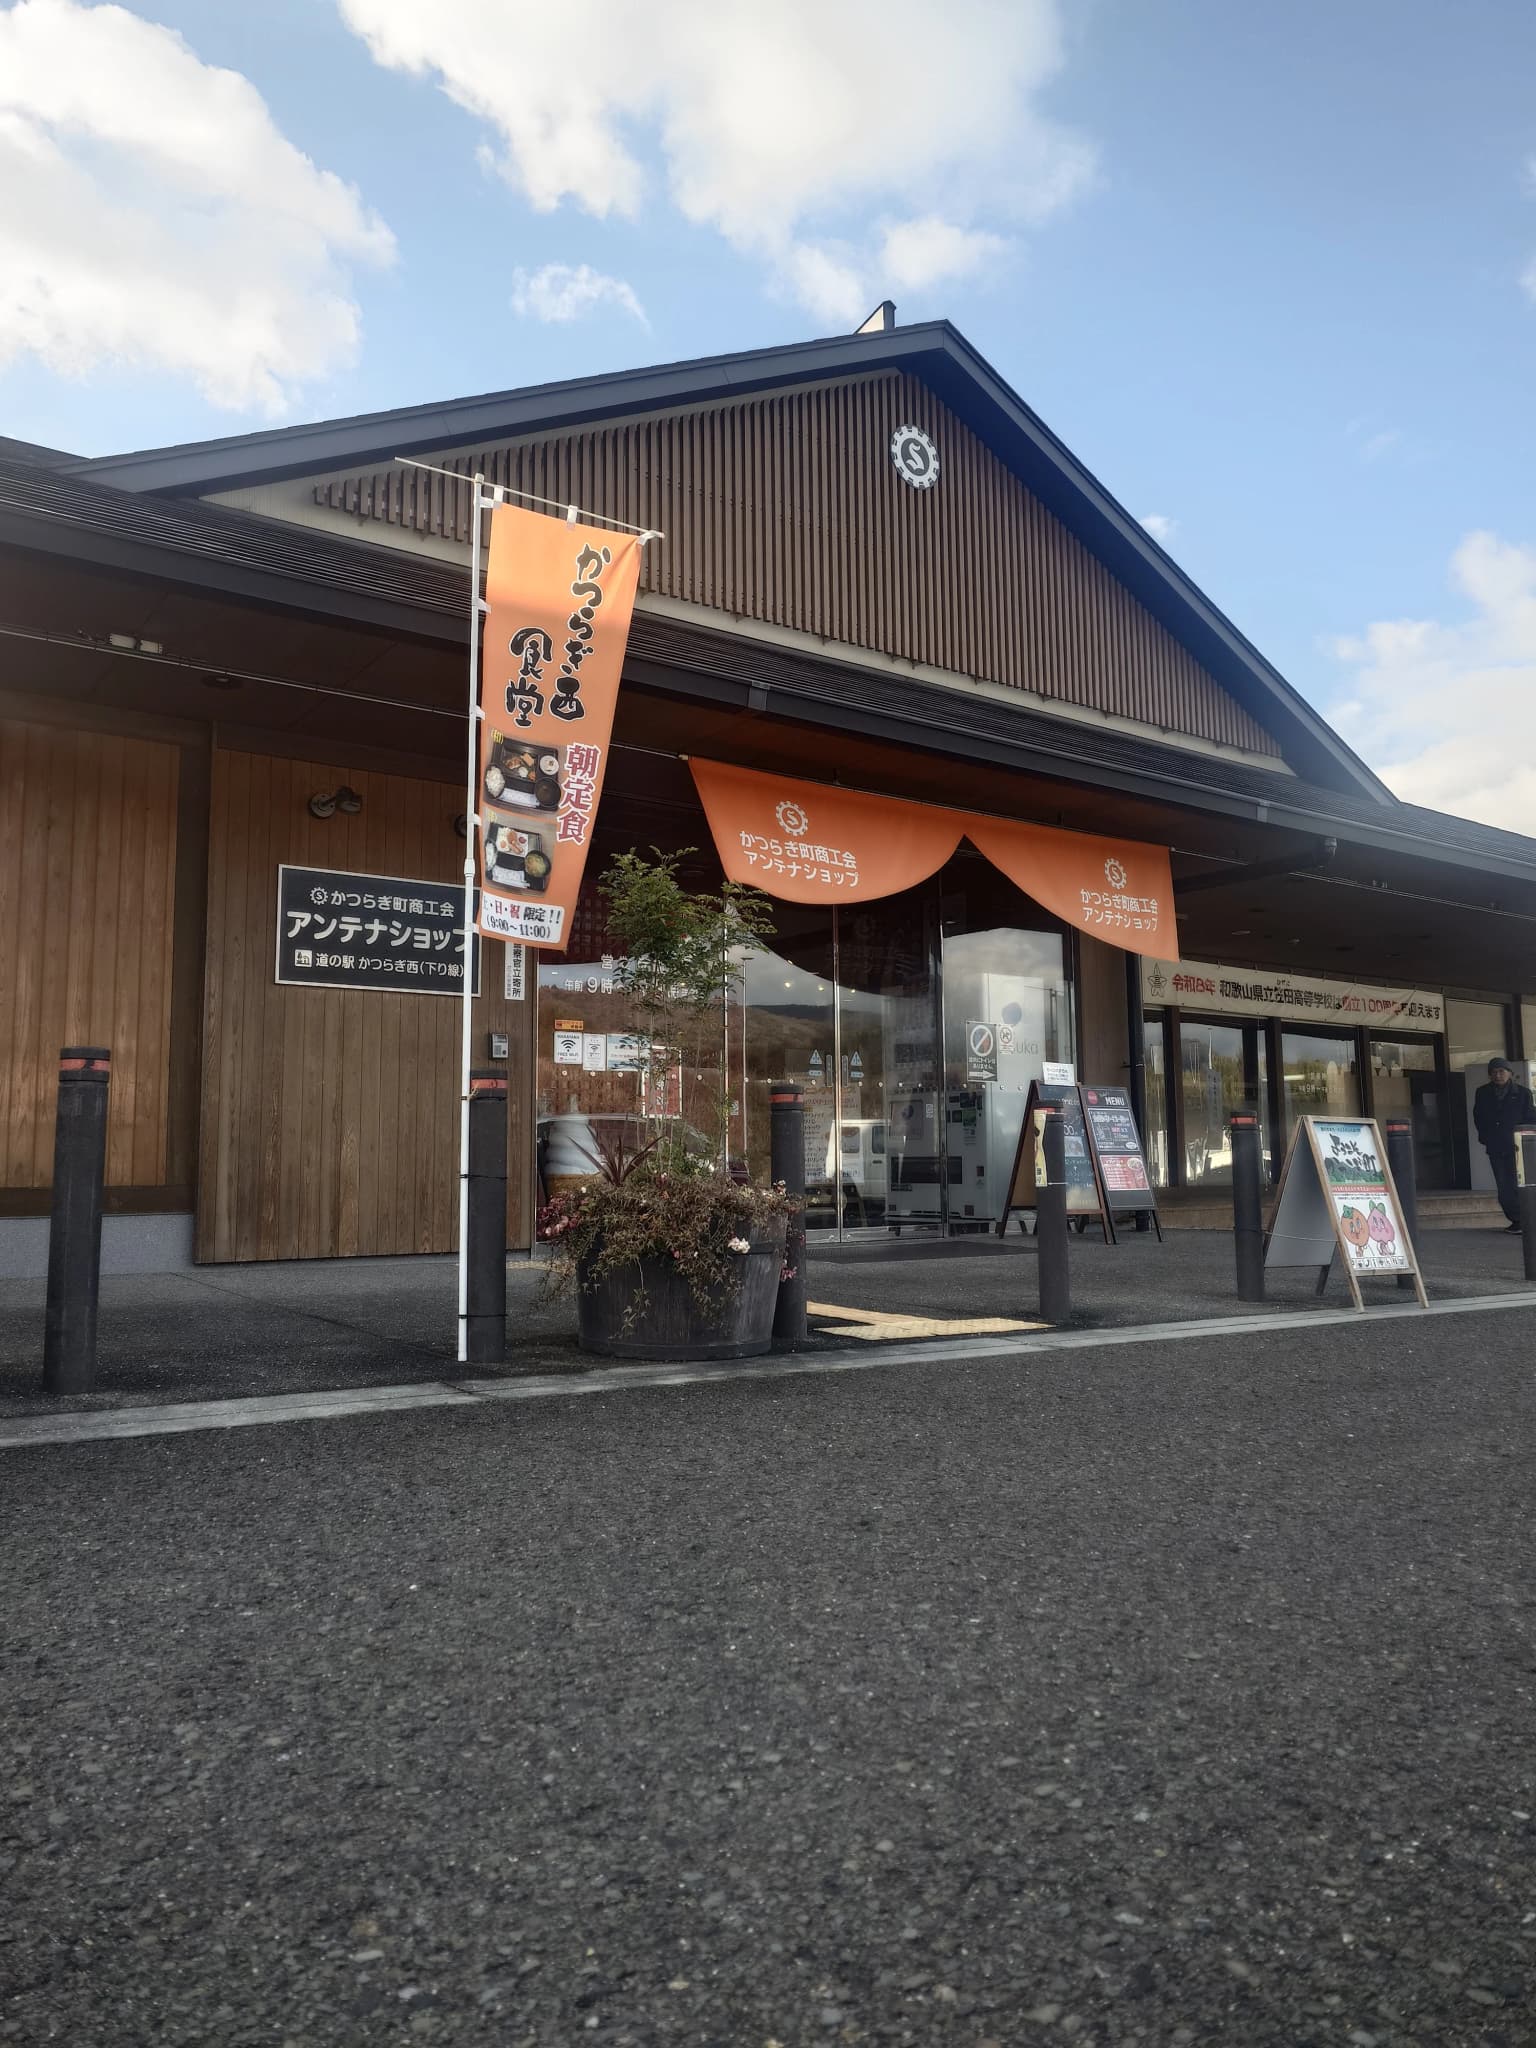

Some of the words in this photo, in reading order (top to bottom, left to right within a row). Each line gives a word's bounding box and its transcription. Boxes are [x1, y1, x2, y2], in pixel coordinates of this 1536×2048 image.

[550, 543, 612, 721] かつらぎ西
[506, 628, 553, 727] 食堂
[557, 742, 602, 846] 朝定食
[739, 830, 857, 870] かつらぎ町商工会
[743, 850, 860, 888] アンテナショップ
[330, 890, 455, 918] かつらぎ町商工会
[1080, 888, 1159, 915] かつらぎ町商工会
[1081, 906, 1159, 932] アンテナショップ
[315, 952, 355, 970] 道の駅
[358, 955, 465, 978] かつらぎ西(下り線)
[1172, 973, 1216, 996] 令和8年
